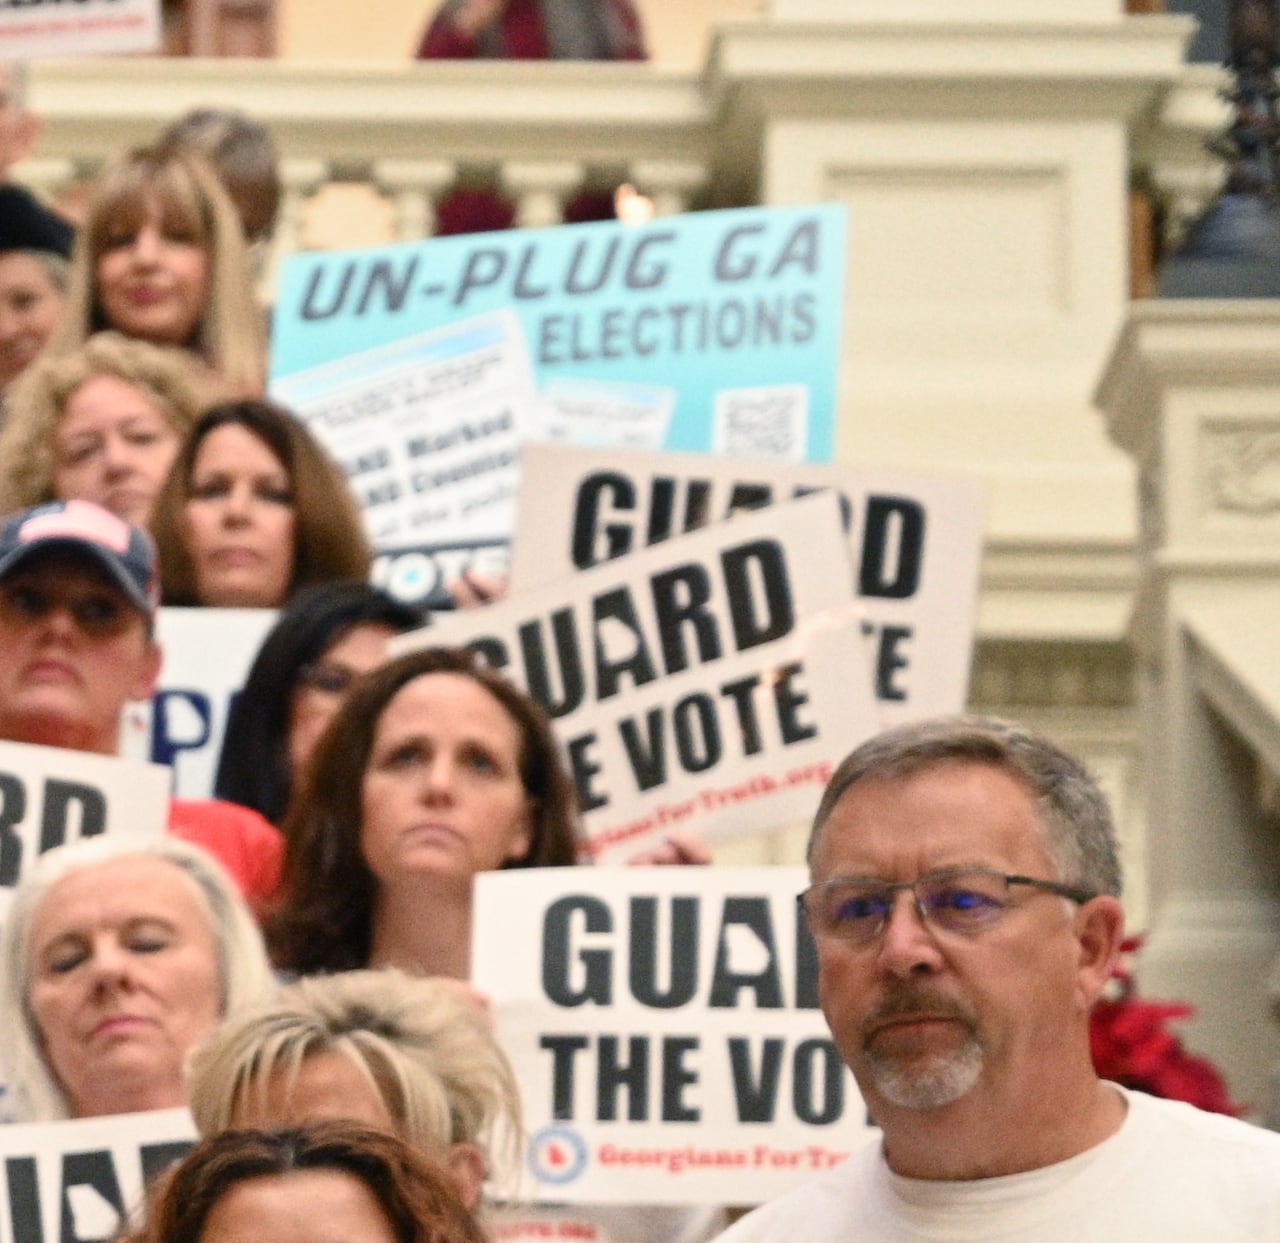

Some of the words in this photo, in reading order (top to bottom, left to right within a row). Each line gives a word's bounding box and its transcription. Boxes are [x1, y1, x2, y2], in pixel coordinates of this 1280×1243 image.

[298, 229, 678, 322] UN-PLUG
[712, 219, 821, 282] GA
[538, 294, 817, 365] ELECTIONS
[617, 662, 817, 791] VOTE
[540, 1033, 701, 1124] THE
